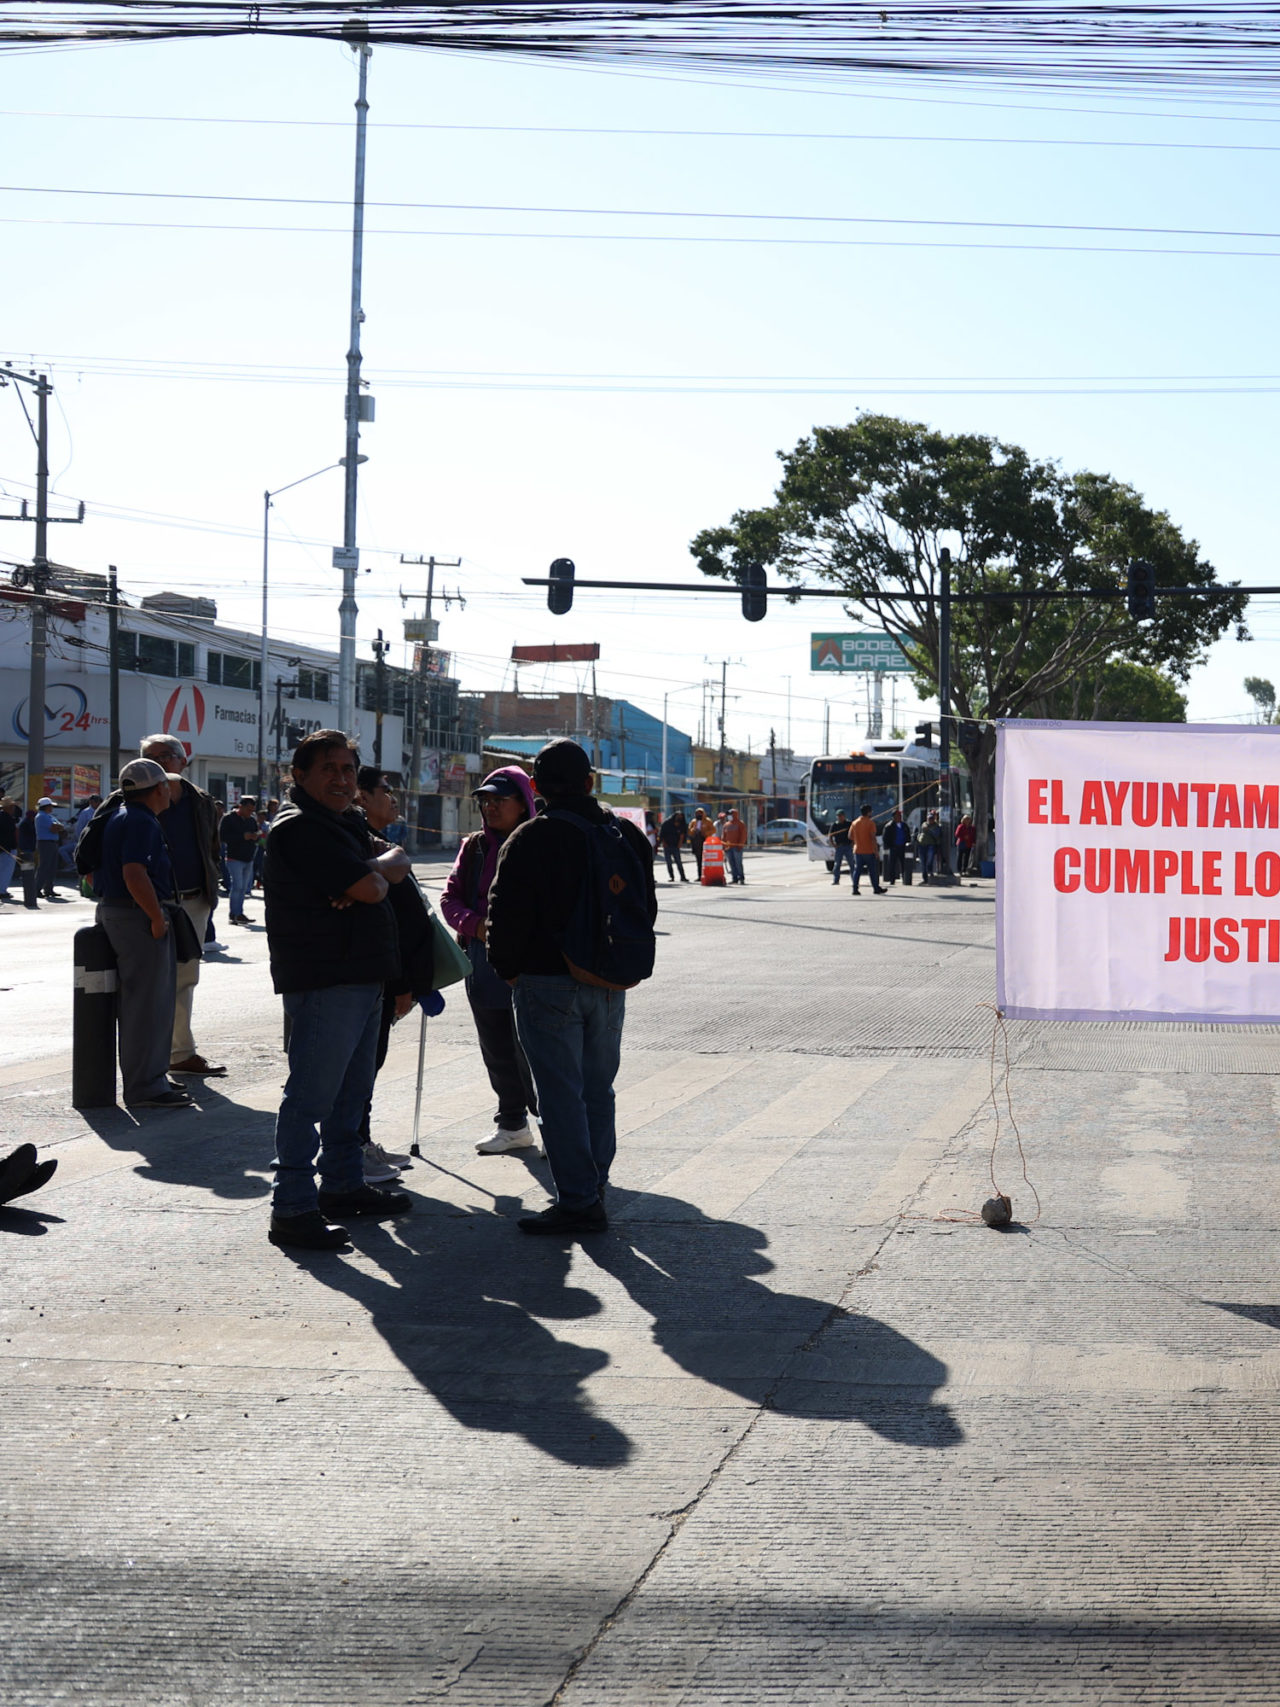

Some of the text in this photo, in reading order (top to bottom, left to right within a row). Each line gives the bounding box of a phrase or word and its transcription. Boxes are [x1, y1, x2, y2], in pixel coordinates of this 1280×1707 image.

[820, 653, 911, 667] AURRE
[60, 712, 91, 731] 24
[215, 705, 256, 724] Farmacias
[269, 706, 321, 737] Ahrro
[1028, 779, 1070, 825] EL
[1053, 847, 1223, 896] CUMPLE
